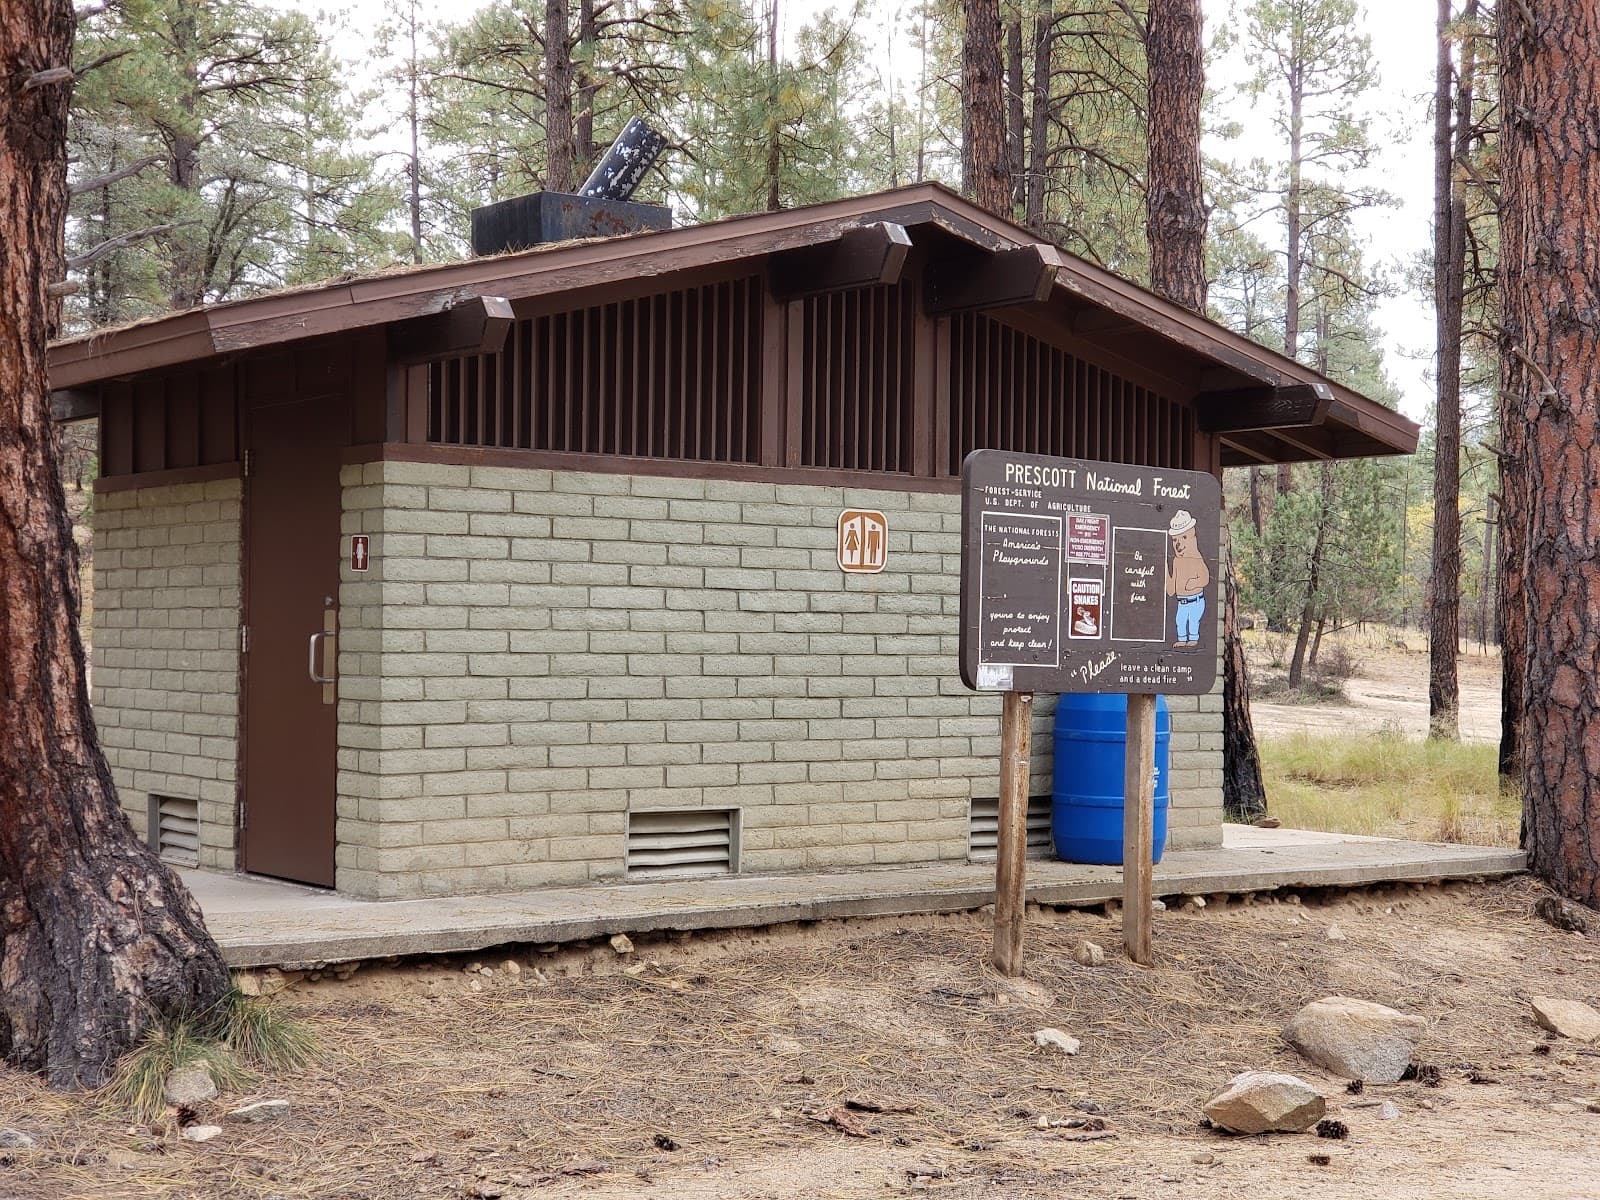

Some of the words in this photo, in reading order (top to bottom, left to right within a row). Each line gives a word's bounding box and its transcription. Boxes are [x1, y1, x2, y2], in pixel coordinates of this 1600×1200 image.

[1005, 463, 1077, 488] PRESCOTT
[1086, 472, 1142, 496] National
[1153, 478, 1191, 499] Forest
[985, 486, 1042, 498] FOREST-SERVICE
[985, 497, 1000, 506] U.S.
[1005, 498, 1024, 507] DEPT.
[1030, 501, 1039, 509] OF
[1047, 501, 1091, 512] AGRICULTURE
[984, 524, 997, 533] THE
[998, 525, 1030, 535] NATIONAL
[1031, 528, 1059, 537] FORESTS
[1003, 538, 1041, 550] America's
[992, 550, 1049, 566] Playgrounds
[1134, 550, 1143, 561] Be
[1124, 565, 1155, 577] careful
[1072, 583, 1100, 594] CAUTION
[1130, 579, 1146, 588] with
[1073, 594, 1099, 606] SNAKES
[1130, 592, 1147, 603] fire
[990, 612, 1014, 622] yours
[1028, 613, 1050, 623] enjoy
[1003, 626, 1032, 635] protect
[990, 639, 1005, 647] and
[1008, 639, 1025, 651] keep
[1120, 663, 1141, 672] leave
[1143, 664, 1148, 672] a
[1150, 664, 1170, 673] clean
[1172, 665, 1192, 675] camp
[1119, 674, 1134, 683] and
[1143, 674, 1161, 684] dead
[1162, 674, 1177, 684] fire
